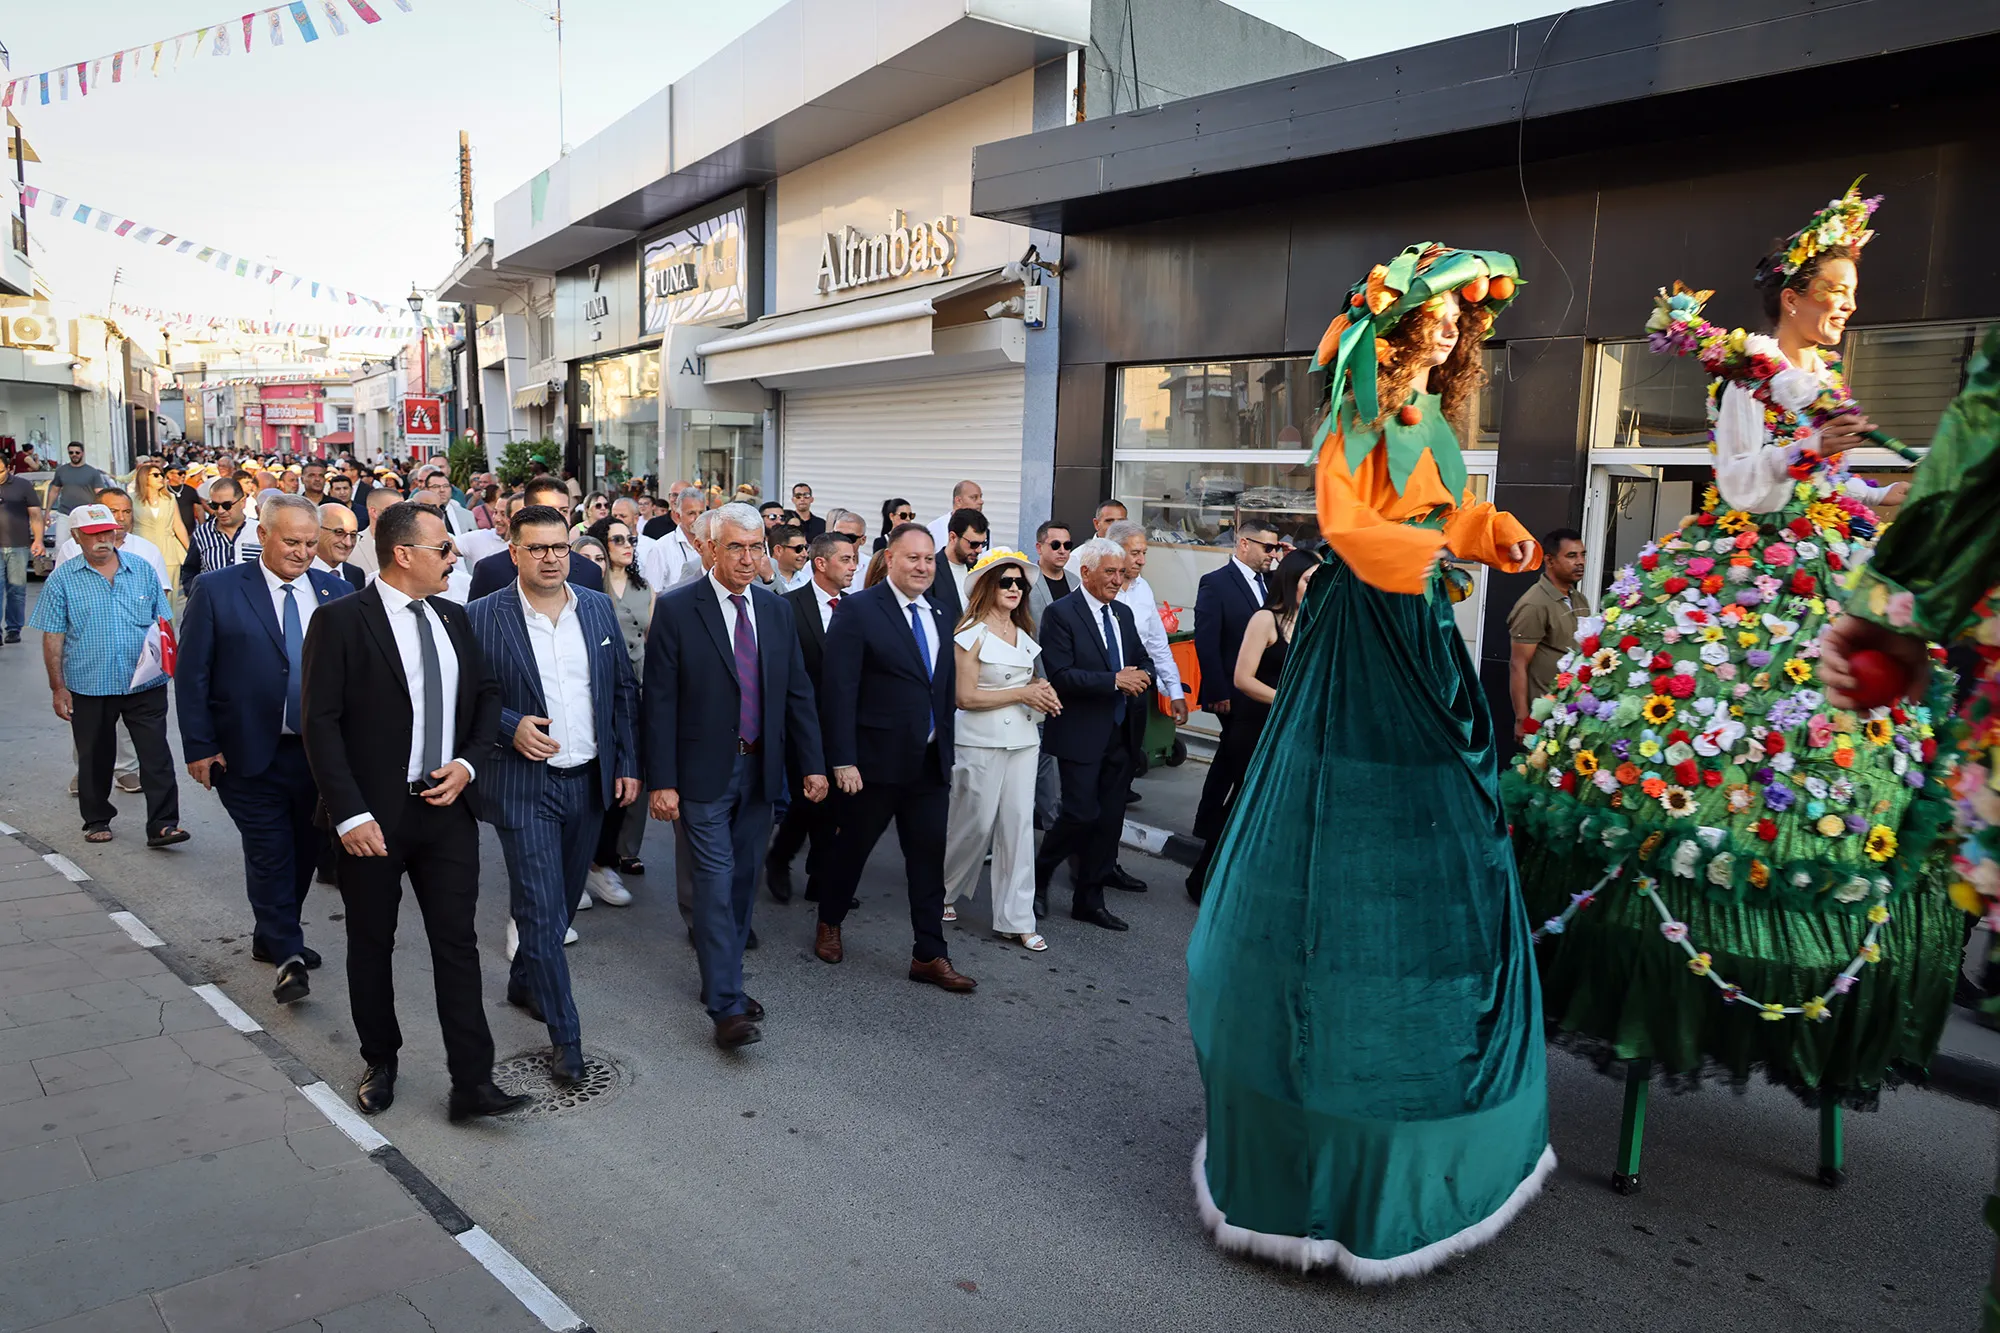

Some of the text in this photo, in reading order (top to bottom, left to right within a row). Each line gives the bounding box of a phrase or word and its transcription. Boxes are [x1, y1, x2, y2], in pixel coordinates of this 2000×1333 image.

[814, 208, 956, 295] Altınbaş
[652, 263, 696, 298] TUNA
[582, 296, 609, 321] TUNA
[680, 357, 704, 376] Al
